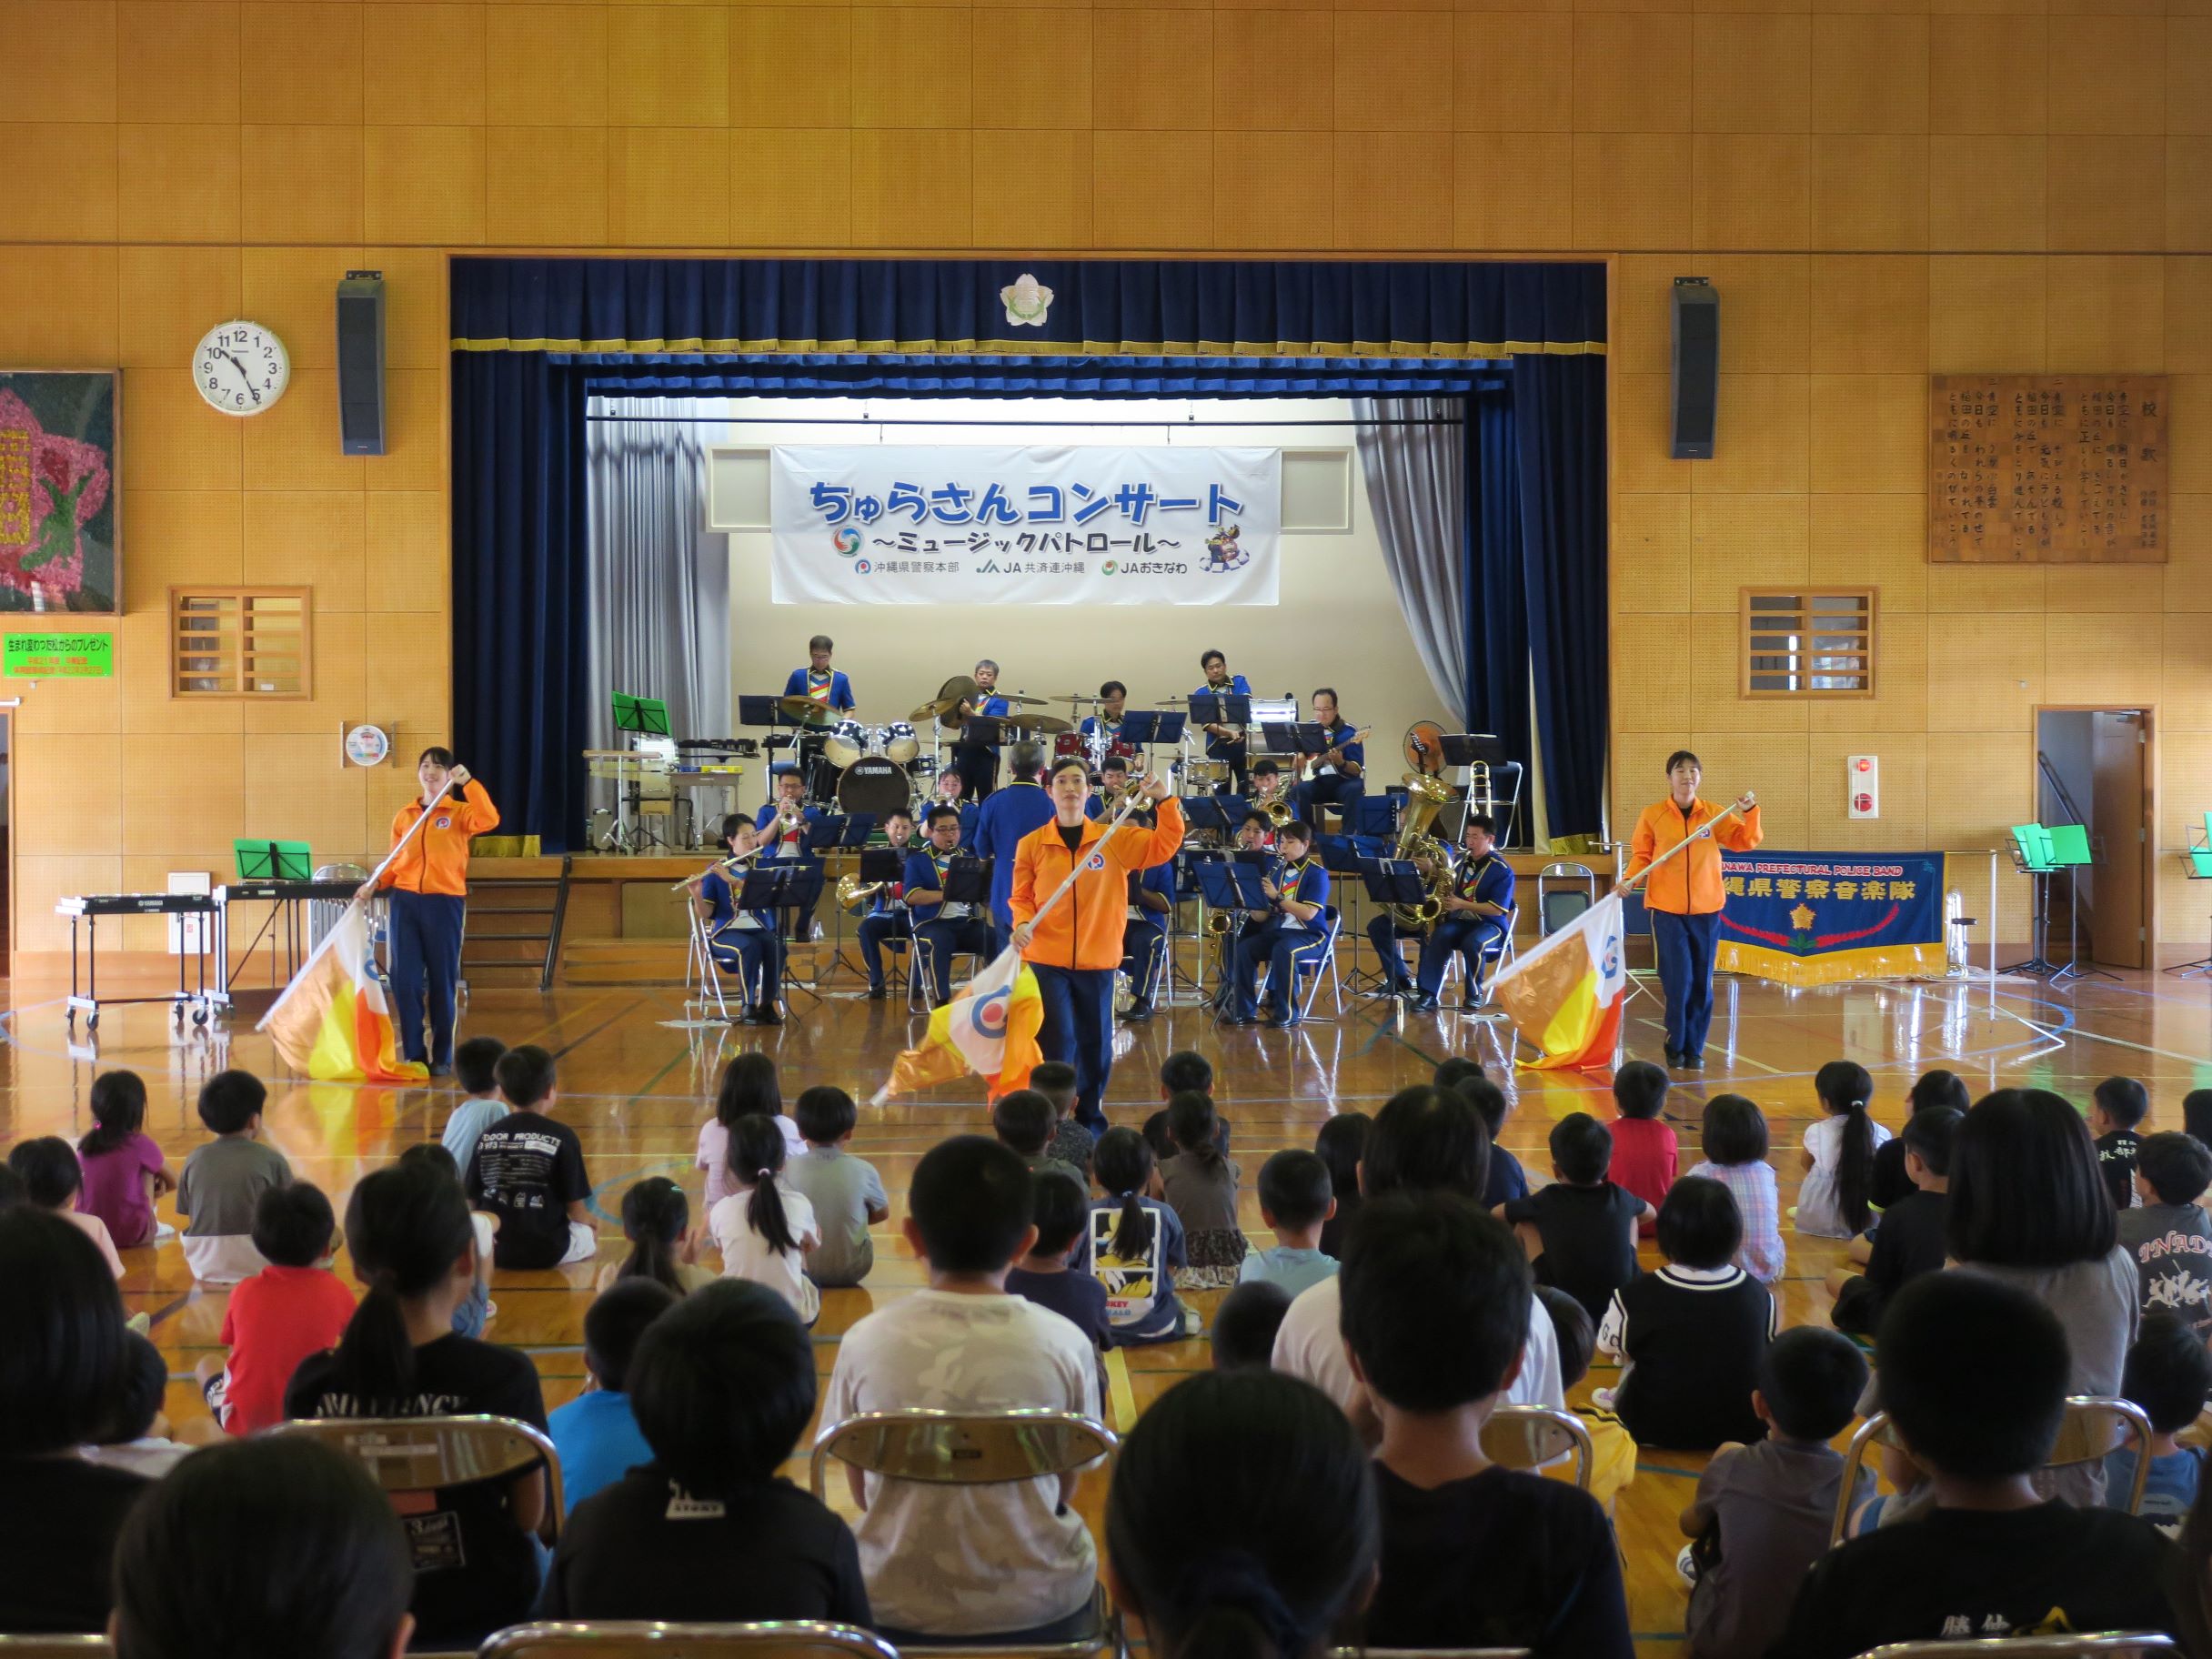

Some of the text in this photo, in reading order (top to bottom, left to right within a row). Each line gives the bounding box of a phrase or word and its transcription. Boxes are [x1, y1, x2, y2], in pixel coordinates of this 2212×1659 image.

[217, 335, 230, 347] 11
[233, 330, 248, 343] 12
[254, 335, 260, 348] 1
[206, 347, 222, 359] 10
[263, 346, 273, 358] 2
[204, 361, 214, 374] 9
[267, 362, 277, 375] 3
[208, 377, 218, 390] 8
[263, 377, 272, 390] 4
[221, 388, 231, 401] 7
[236, 392, 245, 406] 6
[809, 479, 1244, 526] ちゅらさんコンサート
[873, 561, 960, 574] 沖縄県警察本部
[1121, 561, 1188, 574] JAおきなわ
[863, 766, 892, 775] YAMAHA
[1755, 862, 1832, 876] PREFECTURAL
[1833, 863, 1870, 876] POLICE
[1872, 864, 1903, 876] BAND
[1724, 876, 1916, 900] 縄県警察音楽隊
